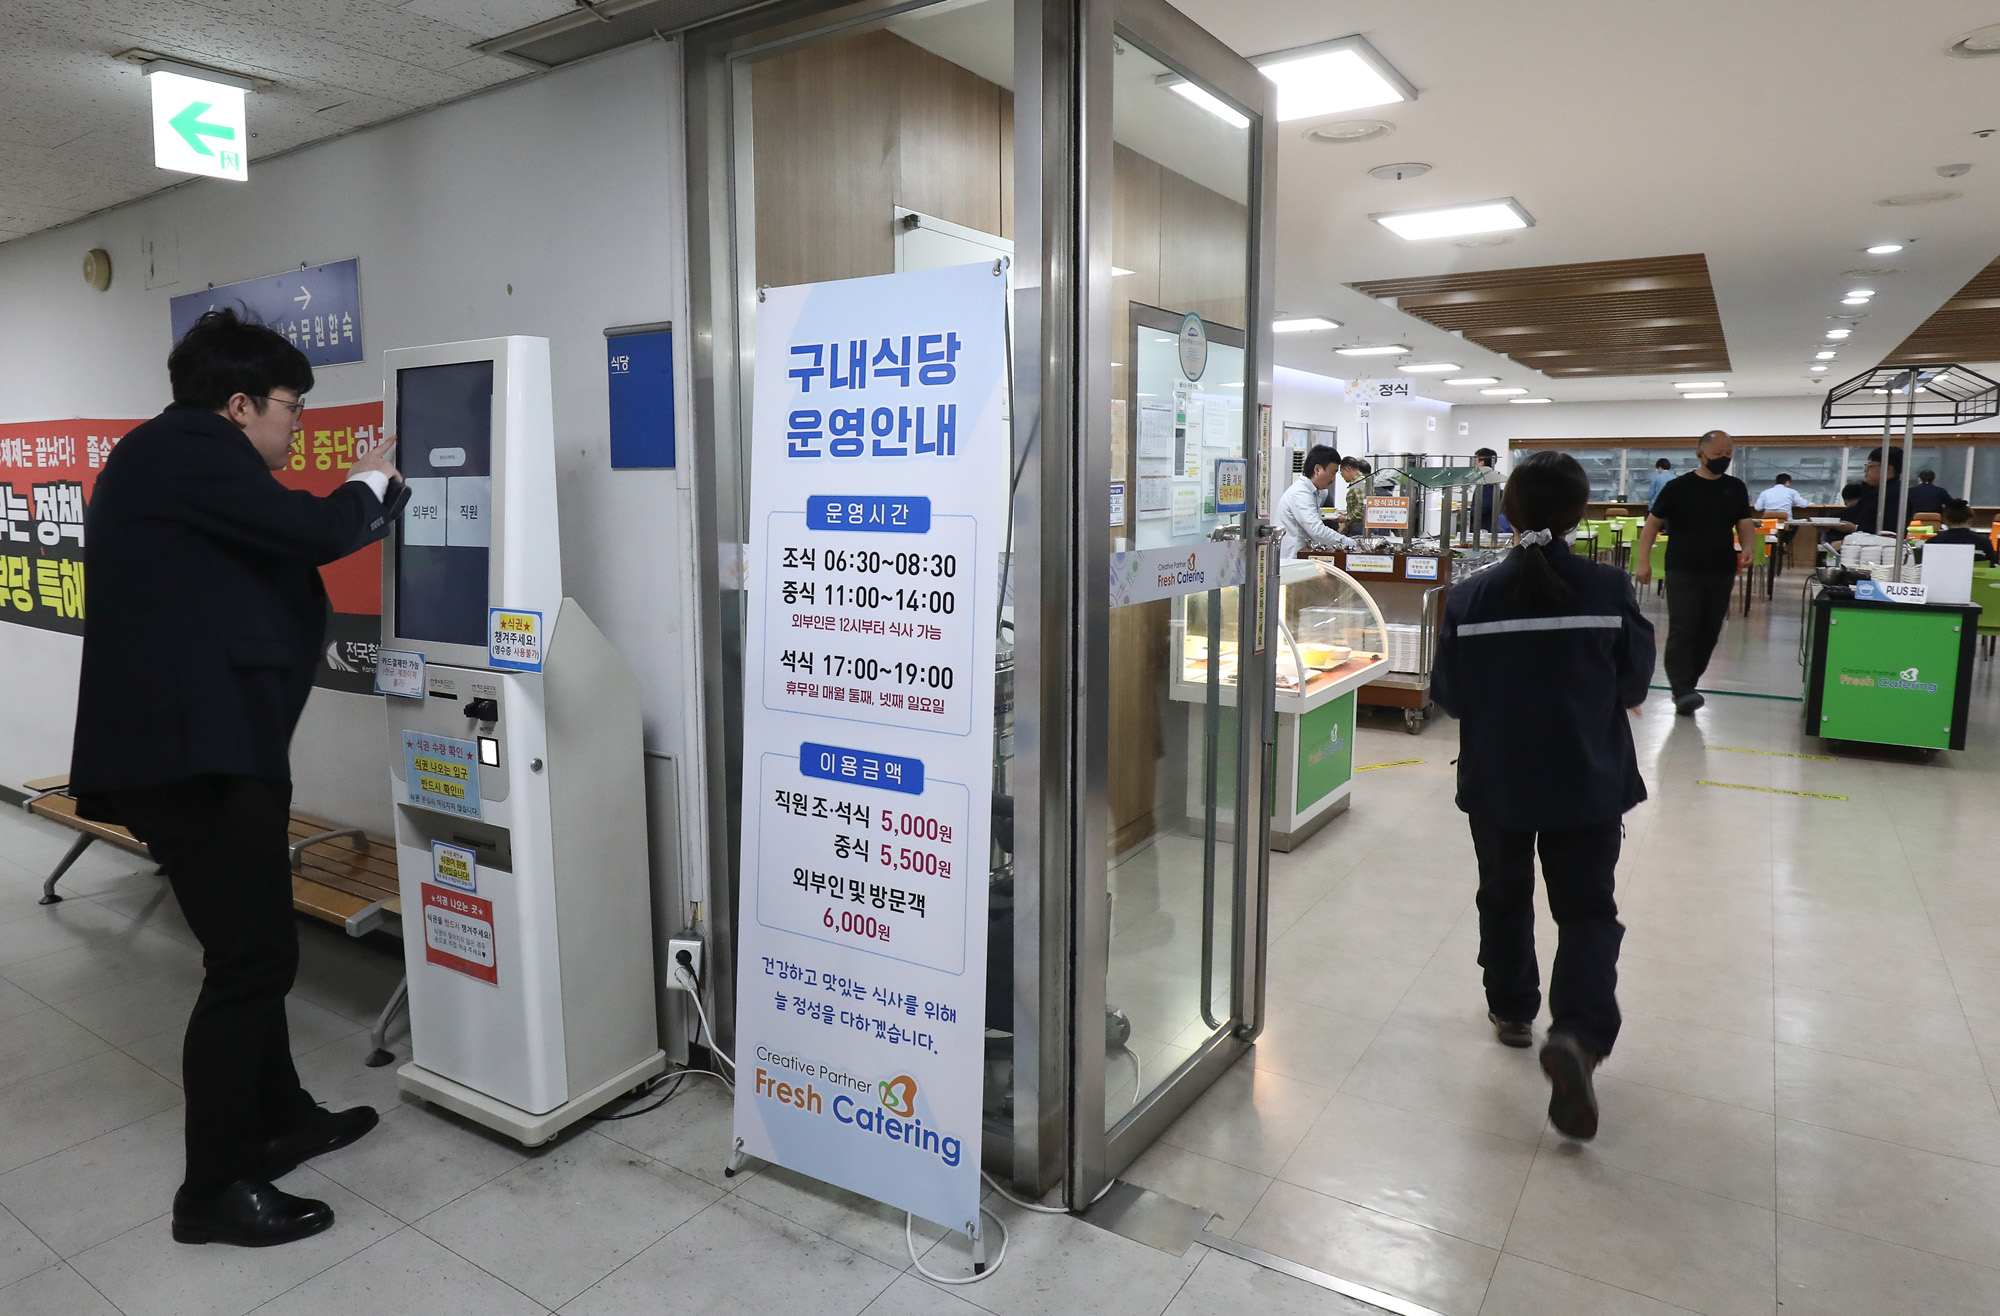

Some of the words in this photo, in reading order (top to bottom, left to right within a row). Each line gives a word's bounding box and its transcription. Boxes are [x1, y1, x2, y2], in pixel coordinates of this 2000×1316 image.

[276, 311, 354, 349] 승무원합숙
[610, 355, 630, 371] 식당
[789, 332, 961, 392] 구내식당
[1379, 383, 1409, 397] 정식
[787, 404, 957, 458] 운영안내
[0, 438, 33, 467] 체제는
[35, 435, 76, 467] 끝났다!
[283, 430, 306, 470] 정
[313, 424, 383, 471] 중단하
[33, 484, 85, 548] 정책
[413, 506, 438, 520] 외부인
[460, 505, 478, 520] 직원
[826, 502, 909, 526] 운영시간
[782, 547, 816, 571] 조식
[824, 550, 957, 578] 06:30~08:30
[1158, 573, 1175, 587] Fresh
[1177, 569, 1205, 585] Catering
[36, 558, 86, 619] 특혜
[782, 581, 816, 605] 중식
[825, 584, 956, 614] 11:00~14:00
[1886, 585, 1909, 596] PLUS
[494, 631, 536, 647] 챙겨주세요!
[508, 618, 523, 631] 식권
[792, 614, 836, 631] 외부인은
[840, 618, 885, 637] 12시부터
[889, 622, 914, 639] 식사
[918, 624, 943, 641] 가능
[492, 645, 511, 656] (영수증
[780, 649, 814, 675] 석식
[823, 655, 954, 690] 17:00~19:00
[1841, 675, 1875, 687] Fresh
[1879, 678, 1938, 693] Catering
[786, 681, 819, 699] 휴무일
[823, 686, 845, 701] 매월
[849, 689, 876, 706] 둘째,
[880, 693, 904, 709] 넷째
[908, 696, 946, 714] 일요일
[416, 739, 430, 752] 식권
[432, 744, 446, 756] 수량
[449, 746, 464, 759] 확인
[415, 758, 428, 771] 식권
[431, 761, 450, 774] 나오는
[453, 766, 468, 778] 입구
[820, 752, 902, 785] 이용금액
[421, 778, 441, 791] 반드시
[775, 789, 808, 817] 직원
[882, 809, 952, 844] 5,000원
[834, 834, 869, 862] 중식
[881, 844, 952, 879] 5,500원
[450, 898, 468, 913] 나오는
[793, 867, 844, 899] 외부인
[849, 878, 866, 905] 및
[870, 883, 926, 918] 방문객
[823, 907, 891, 942] 6,000원
[762, 956, 818, 986] 건강하고
[822, 974, 868, 1001] 맛있는
[873, 987, 919, 1016] 식사를
[924, 1001, 957, 1024] 위해
[775, 991, 788, 1011] 늘
[793, 997, 836, 1025] 정성을
[840, 1011, 939, 1055] 다하겠습니다.
[757, 1046, 815, 1076] Creative
[820, 1065, 872, 1094] Partner
[756, 1067, 822, 1114] Fresh
[833, 1094, 961, 1167] Catering
